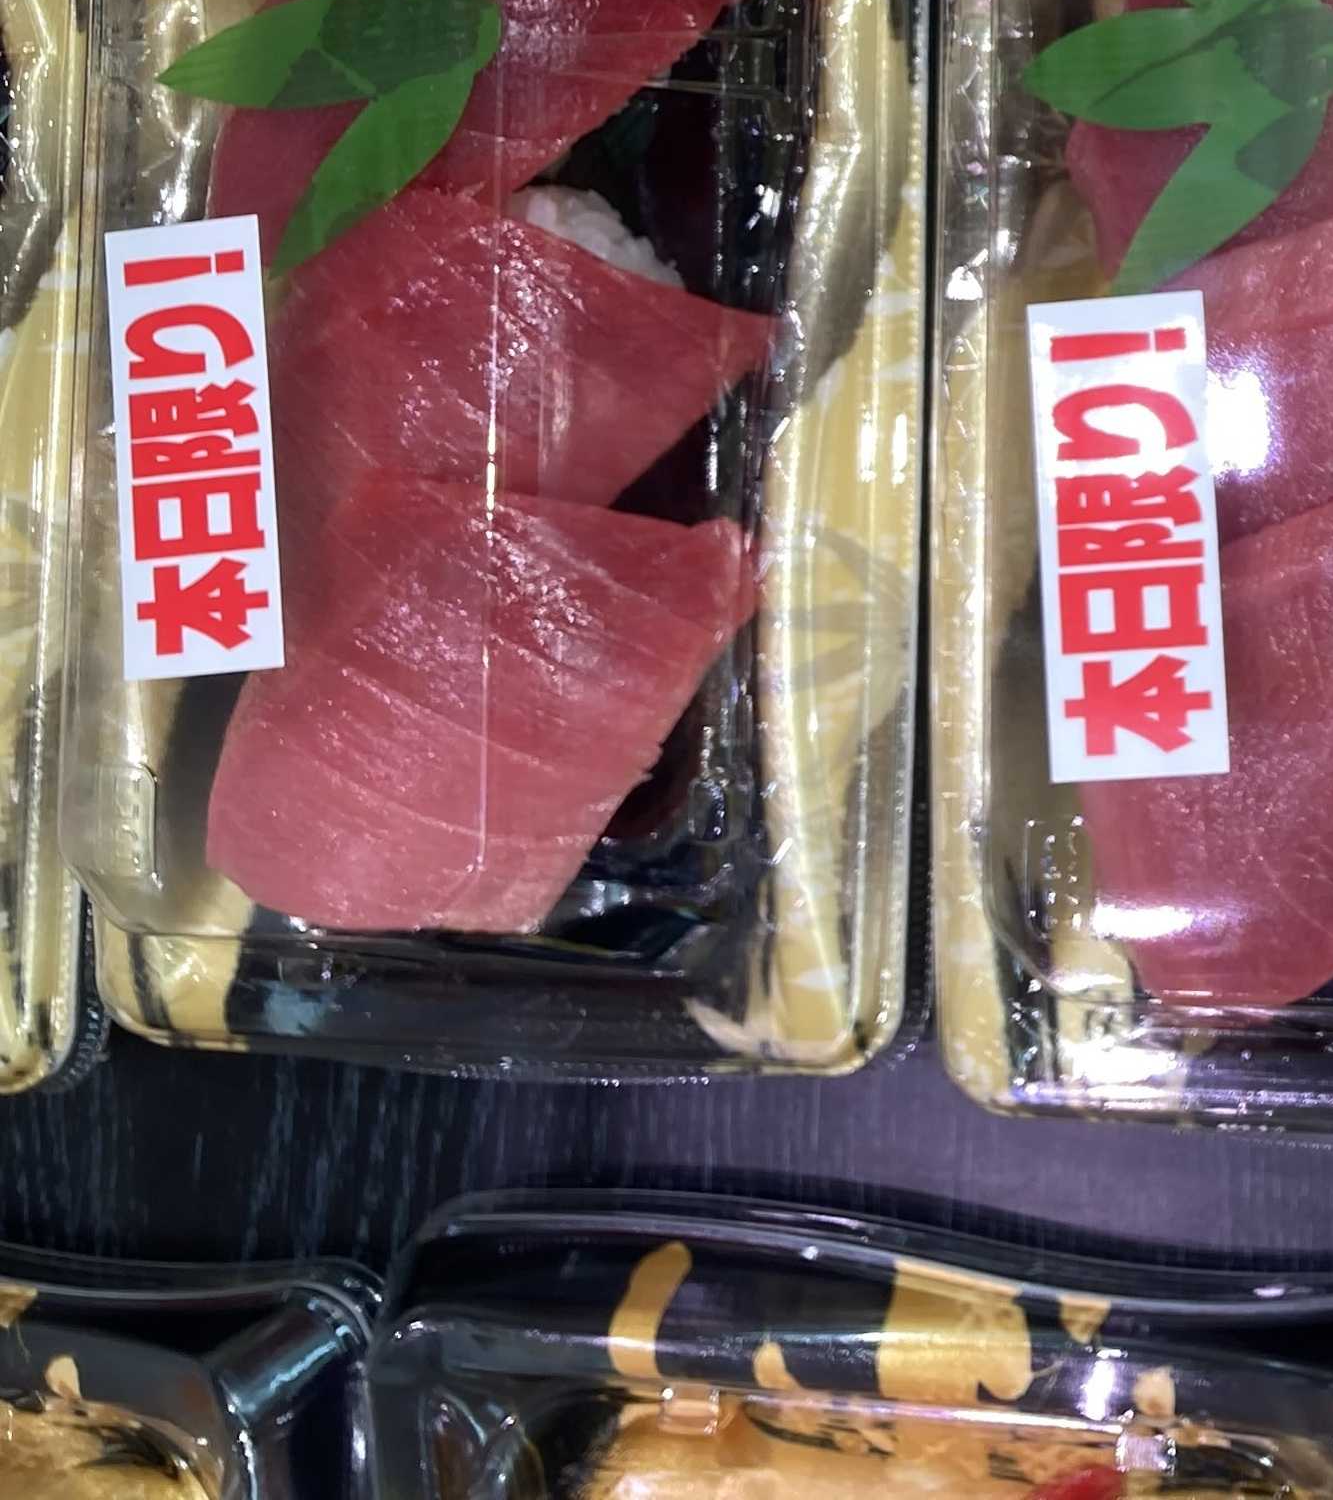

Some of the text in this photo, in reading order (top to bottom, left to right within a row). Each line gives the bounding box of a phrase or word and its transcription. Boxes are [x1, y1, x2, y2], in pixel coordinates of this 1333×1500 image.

[123, 249, 269, 655] 本日限り!
[1050, 327, 1212, 756] 本日限り!
